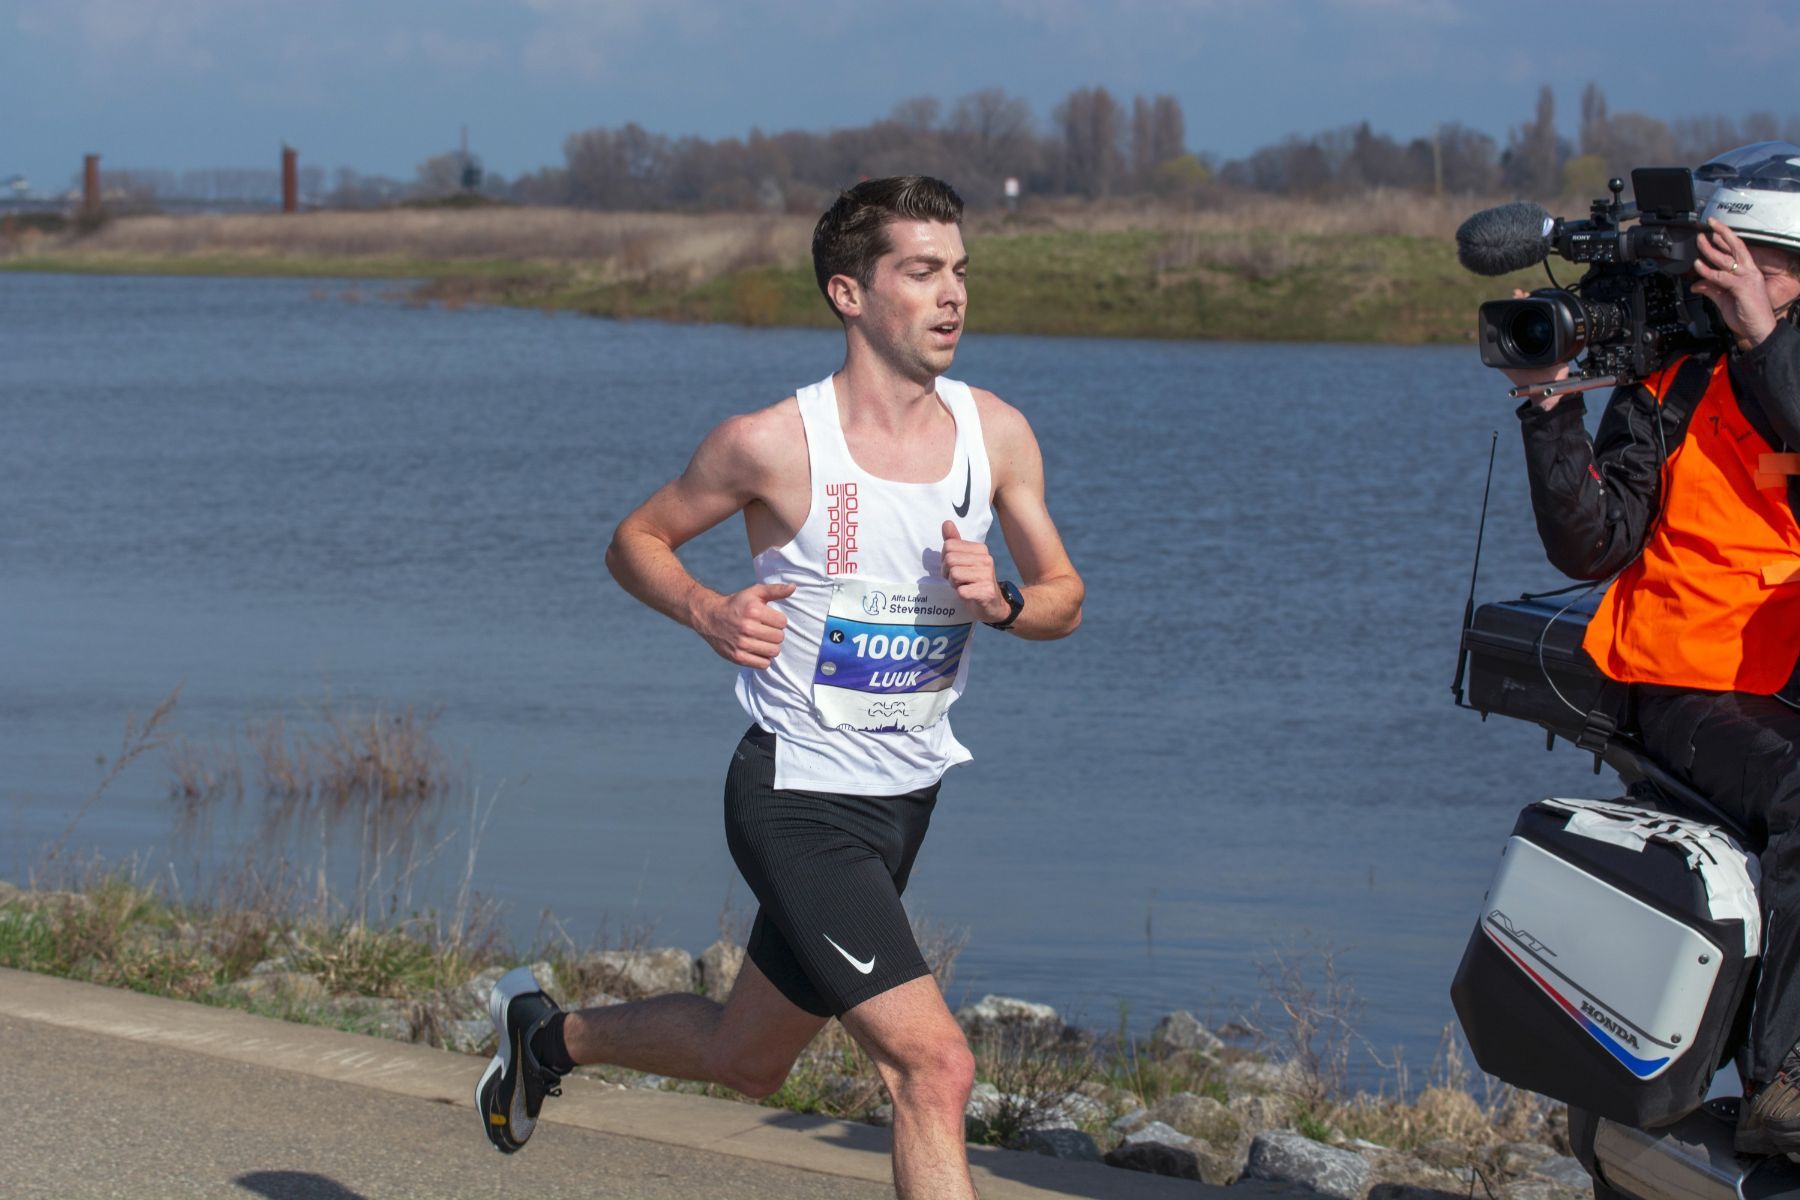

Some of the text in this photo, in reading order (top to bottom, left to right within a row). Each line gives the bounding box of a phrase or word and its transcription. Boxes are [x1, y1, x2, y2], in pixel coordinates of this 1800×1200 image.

[891, 594, 928, 603] Alfa Laval
[889, 604, 956, 617] Stevensloop
[832, 632, 841, 642] K
[851, 633, 949, 660] 10002
[869, 670, 922, 688] LUUK
[867, 708, 910, 717] LAVAL
[1580, 1000, 1640, 1050] HONDA
